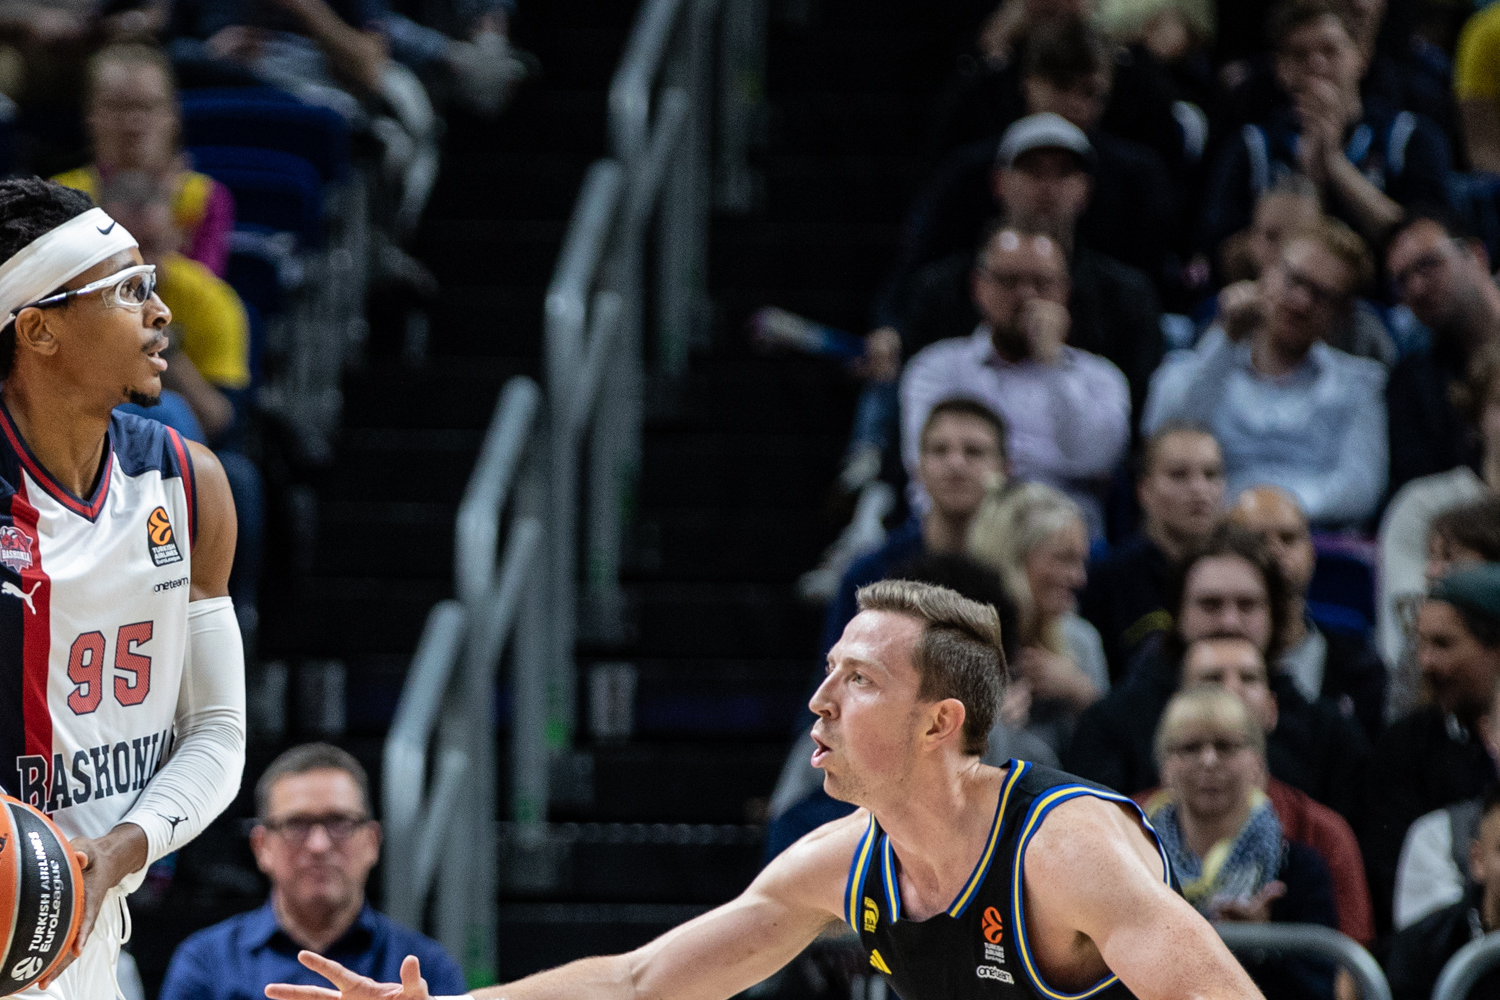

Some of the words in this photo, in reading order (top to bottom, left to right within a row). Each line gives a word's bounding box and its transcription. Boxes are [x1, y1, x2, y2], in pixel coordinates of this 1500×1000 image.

[66, 620, 154, 716] 95
[28, 831, 51, 890] AIRLINES
[28, 893, 51, 951] TURKISH
[38, 860, 65, 952] EuroLeague
